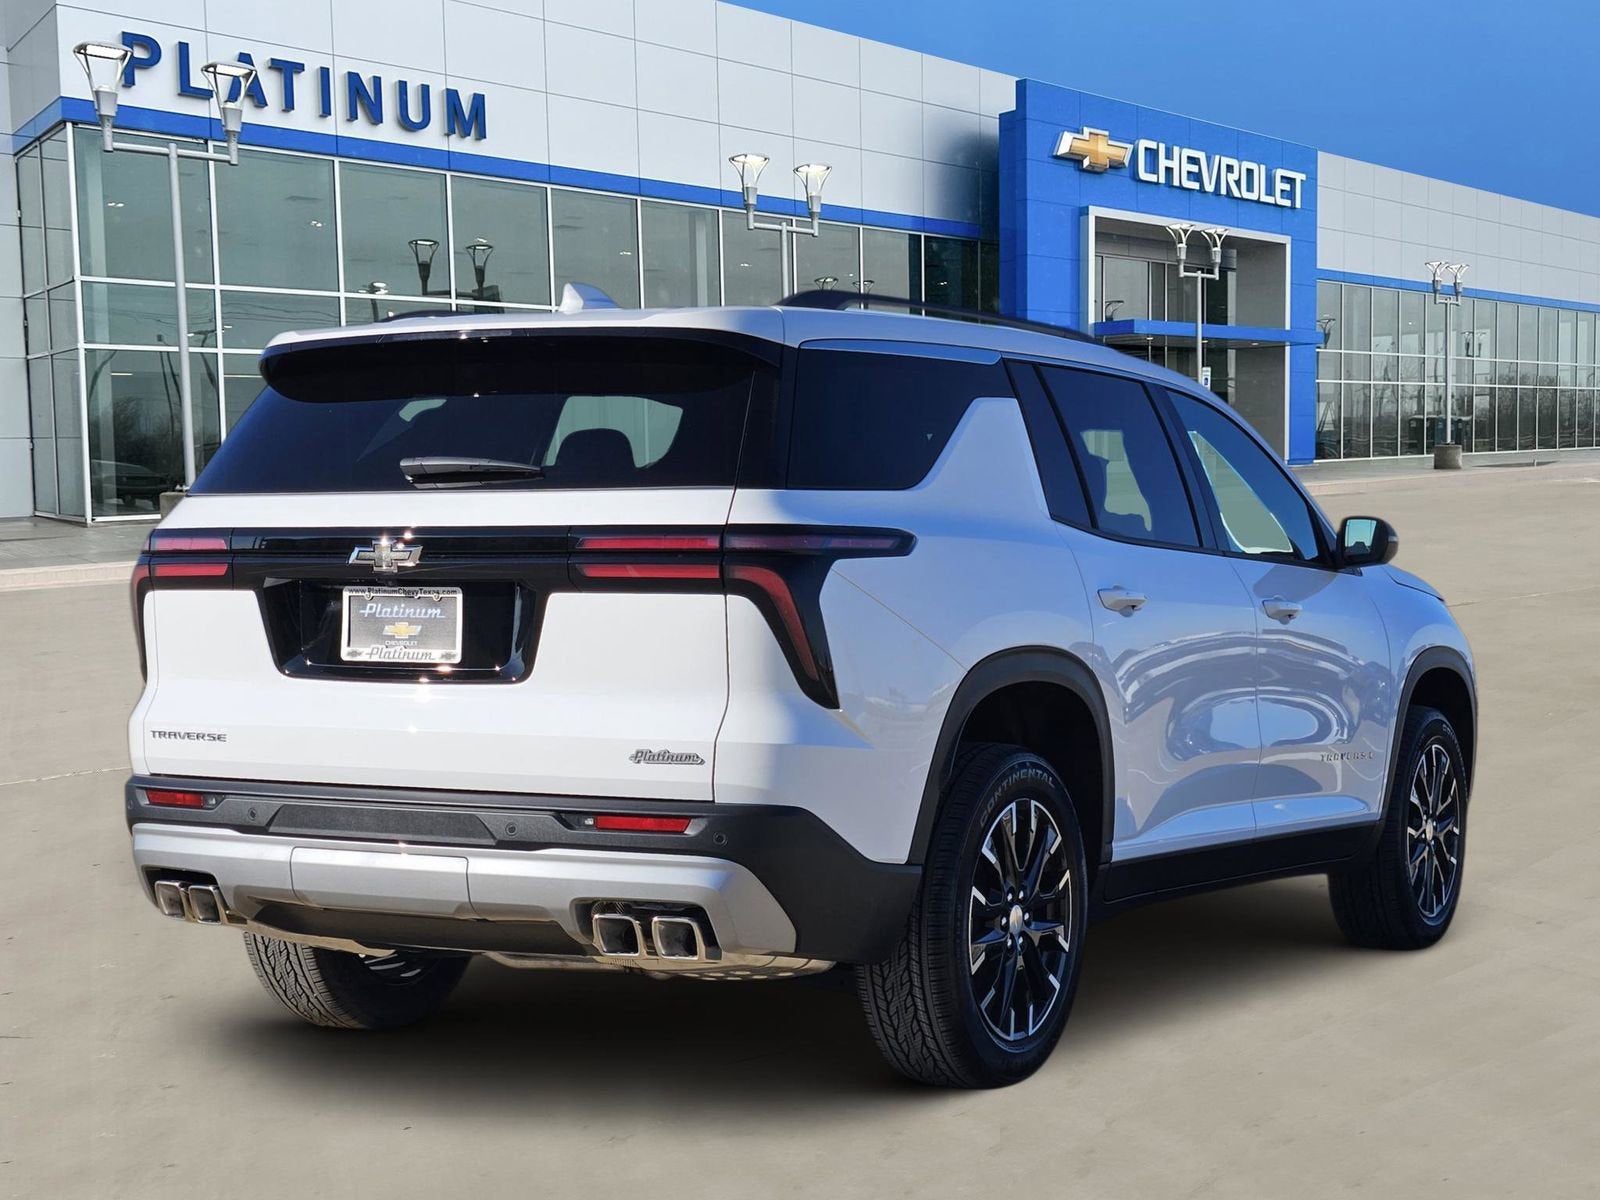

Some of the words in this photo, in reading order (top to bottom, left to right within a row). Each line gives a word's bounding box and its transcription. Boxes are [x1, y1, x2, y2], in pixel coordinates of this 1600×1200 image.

[121, 30, 487, 140] PLATINUM
[1135, 138, 1306, 209] CHEVROLET
[348, 587, 457, 597] www.PlatinumChevyTexas.com
[360, 603, 446, 618] Platinum
[365, 646, 436, 660] Platinum
[150, 730, 227, 742] TRAVERSE
[628, 748, 706, 765] Platinum
